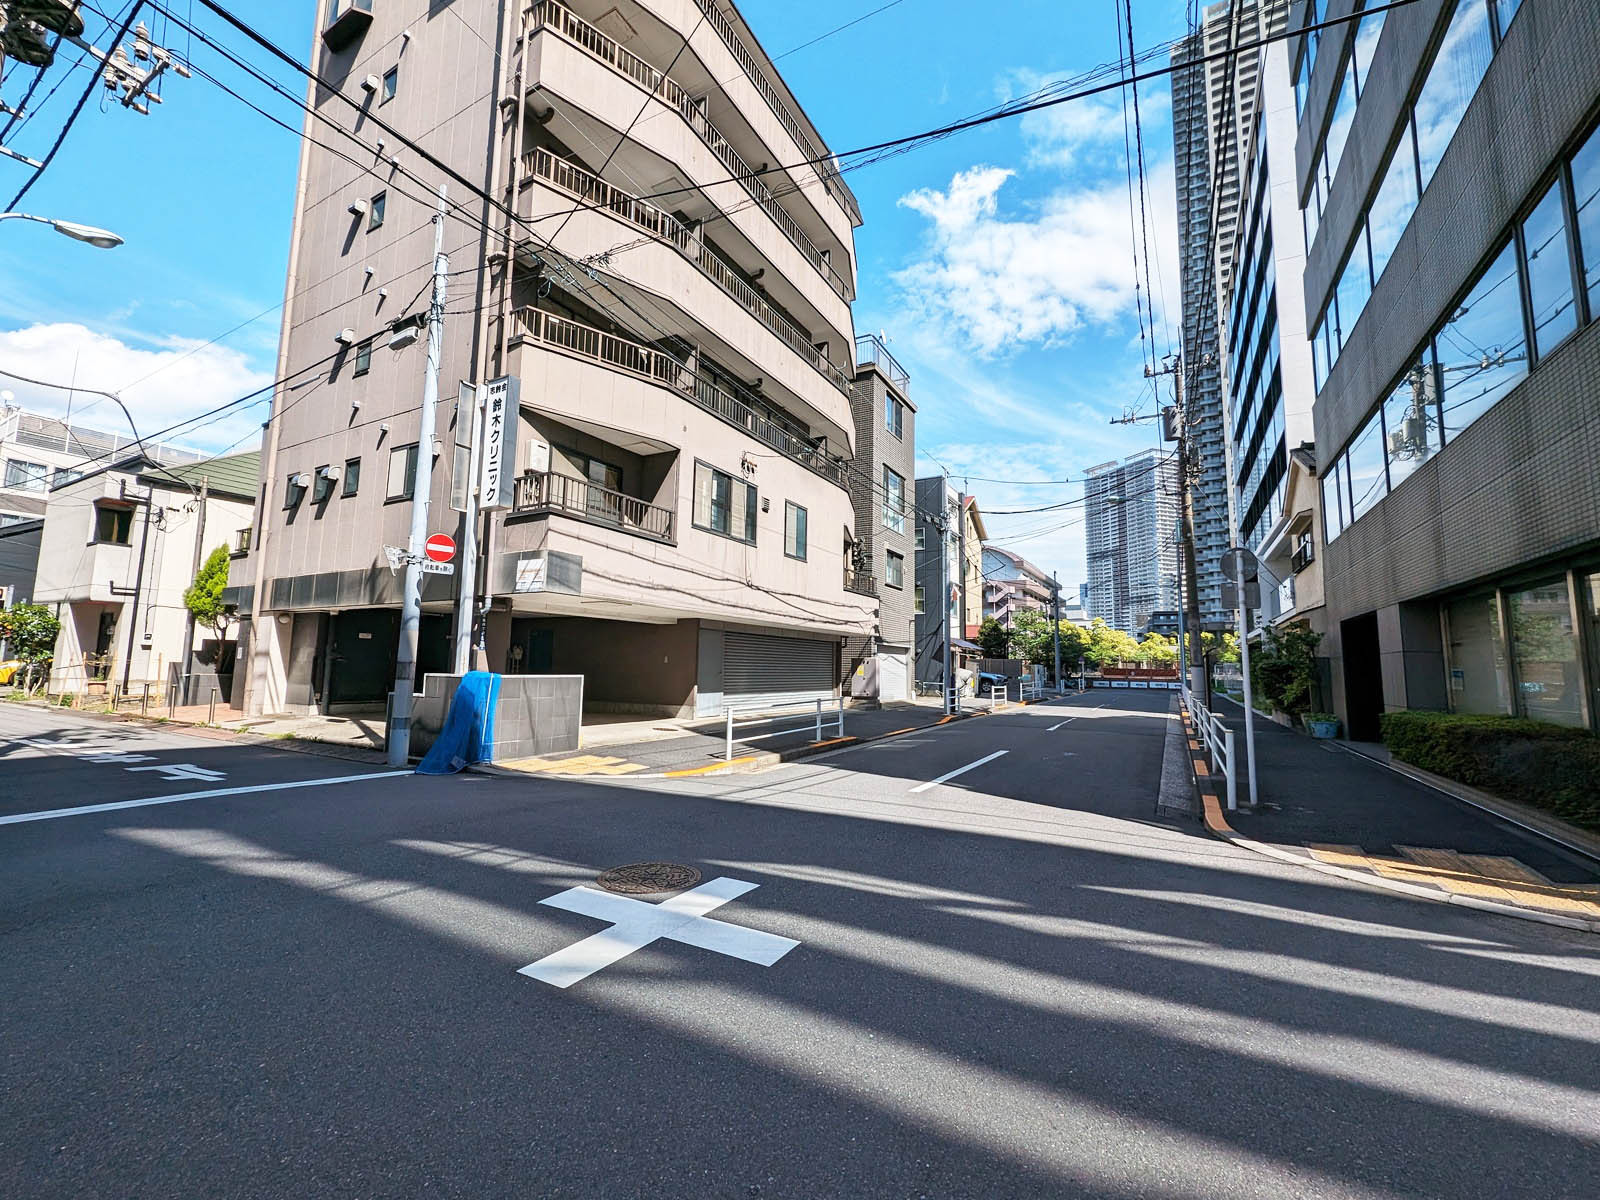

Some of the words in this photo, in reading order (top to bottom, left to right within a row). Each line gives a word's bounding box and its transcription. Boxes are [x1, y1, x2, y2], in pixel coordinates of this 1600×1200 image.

[486, 398, 502, 502] 鈴木クリニック
